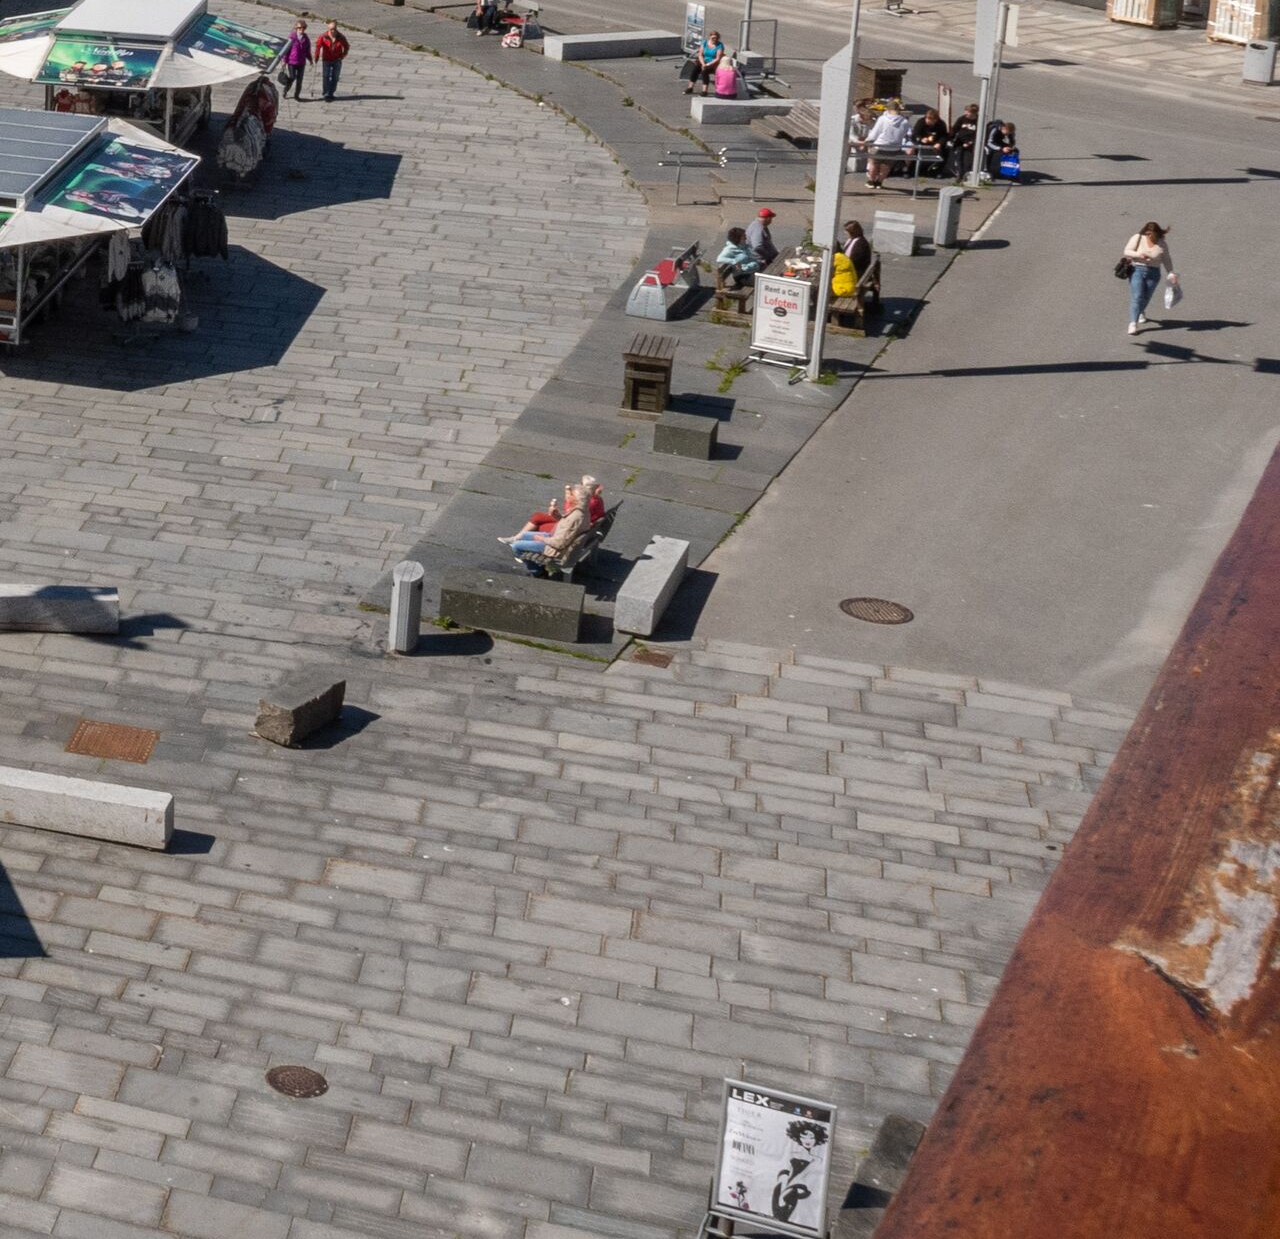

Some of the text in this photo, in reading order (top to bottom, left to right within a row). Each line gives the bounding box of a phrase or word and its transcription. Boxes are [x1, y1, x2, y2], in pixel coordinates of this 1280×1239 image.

[764, 284, 780, 294] Rent
[787, 289, 800, 297] Car
[763, 296, 798, 310] Lofoten
[731, 1088, 770, 1108] LEX
